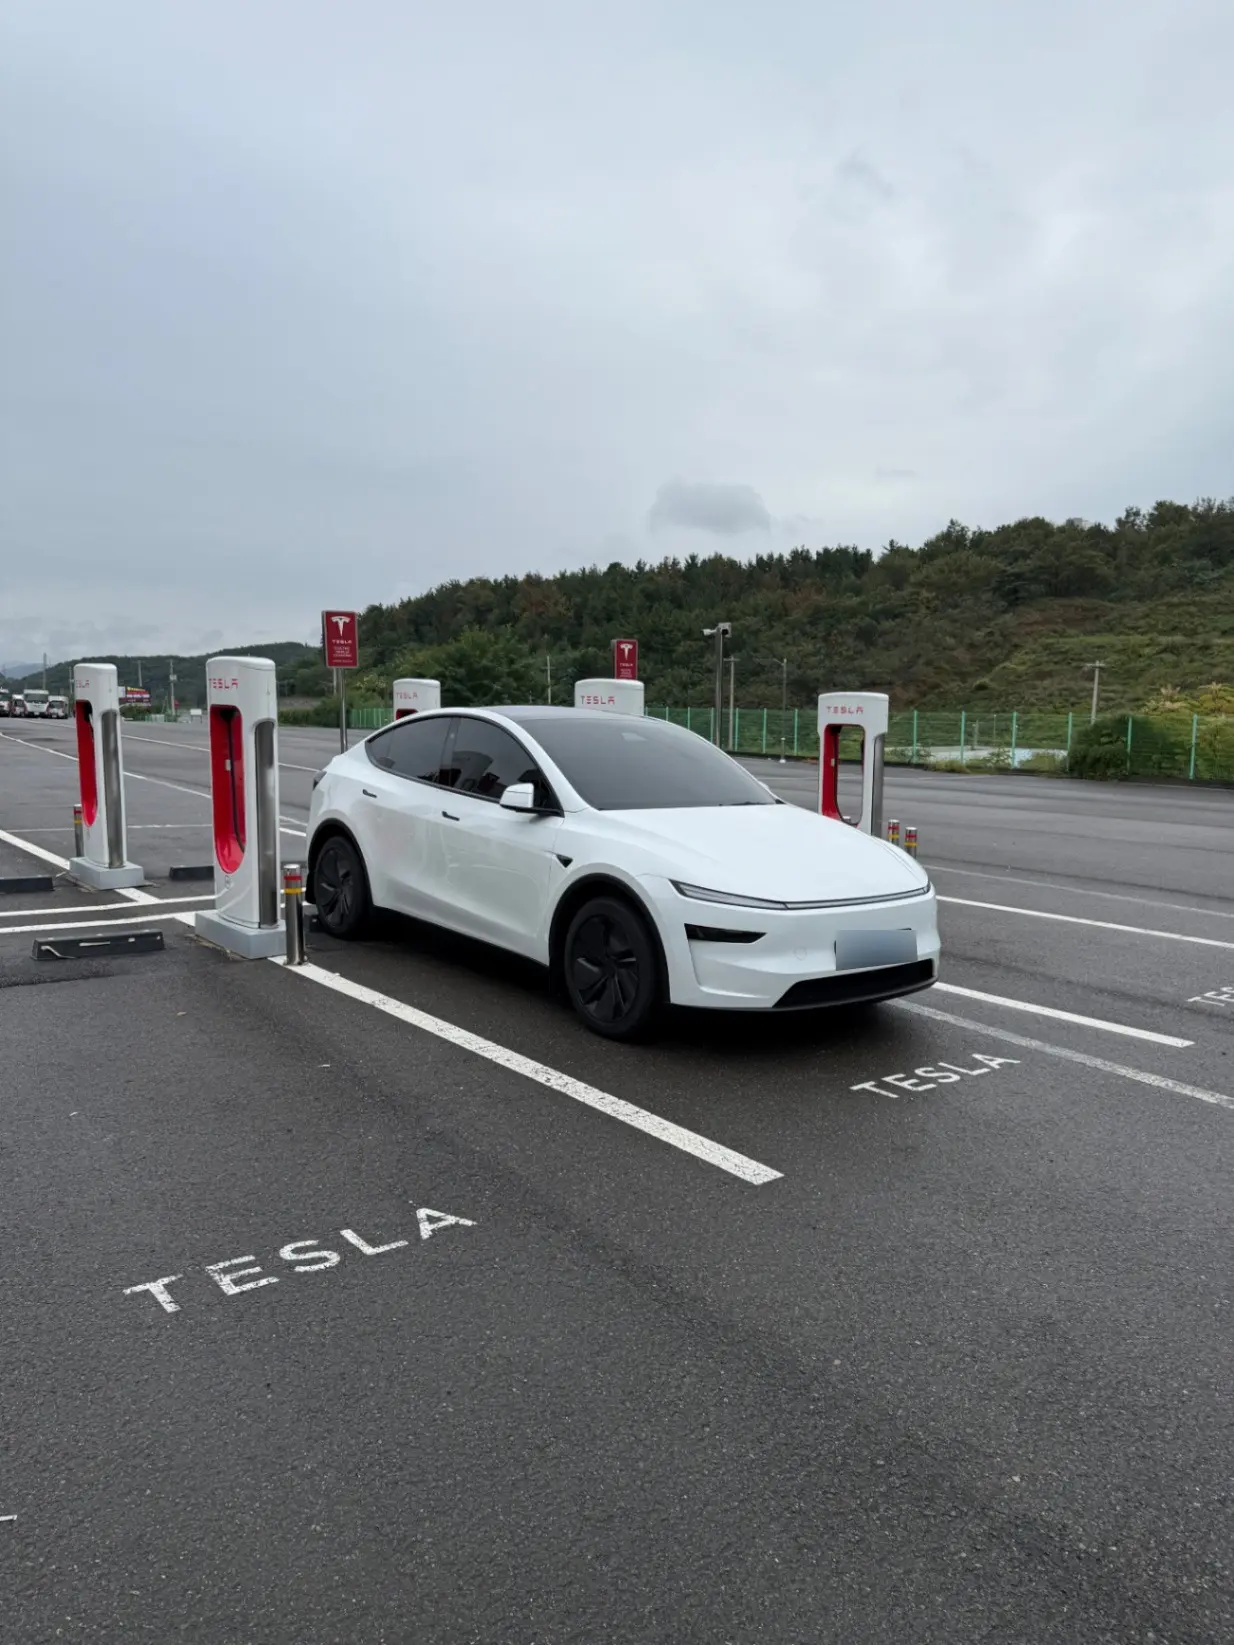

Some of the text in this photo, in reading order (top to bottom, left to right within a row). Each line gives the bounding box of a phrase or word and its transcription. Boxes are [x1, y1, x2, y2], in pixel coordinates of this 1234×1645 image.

[395, 691, 418, 700] TESLA
[580, 695, 615, 705] TESLA
[826, 706, 864, 714] TESLA
[849, 1053, 1021, 1098] TESLA
[122, 1207, 478, 1314] TESLA
